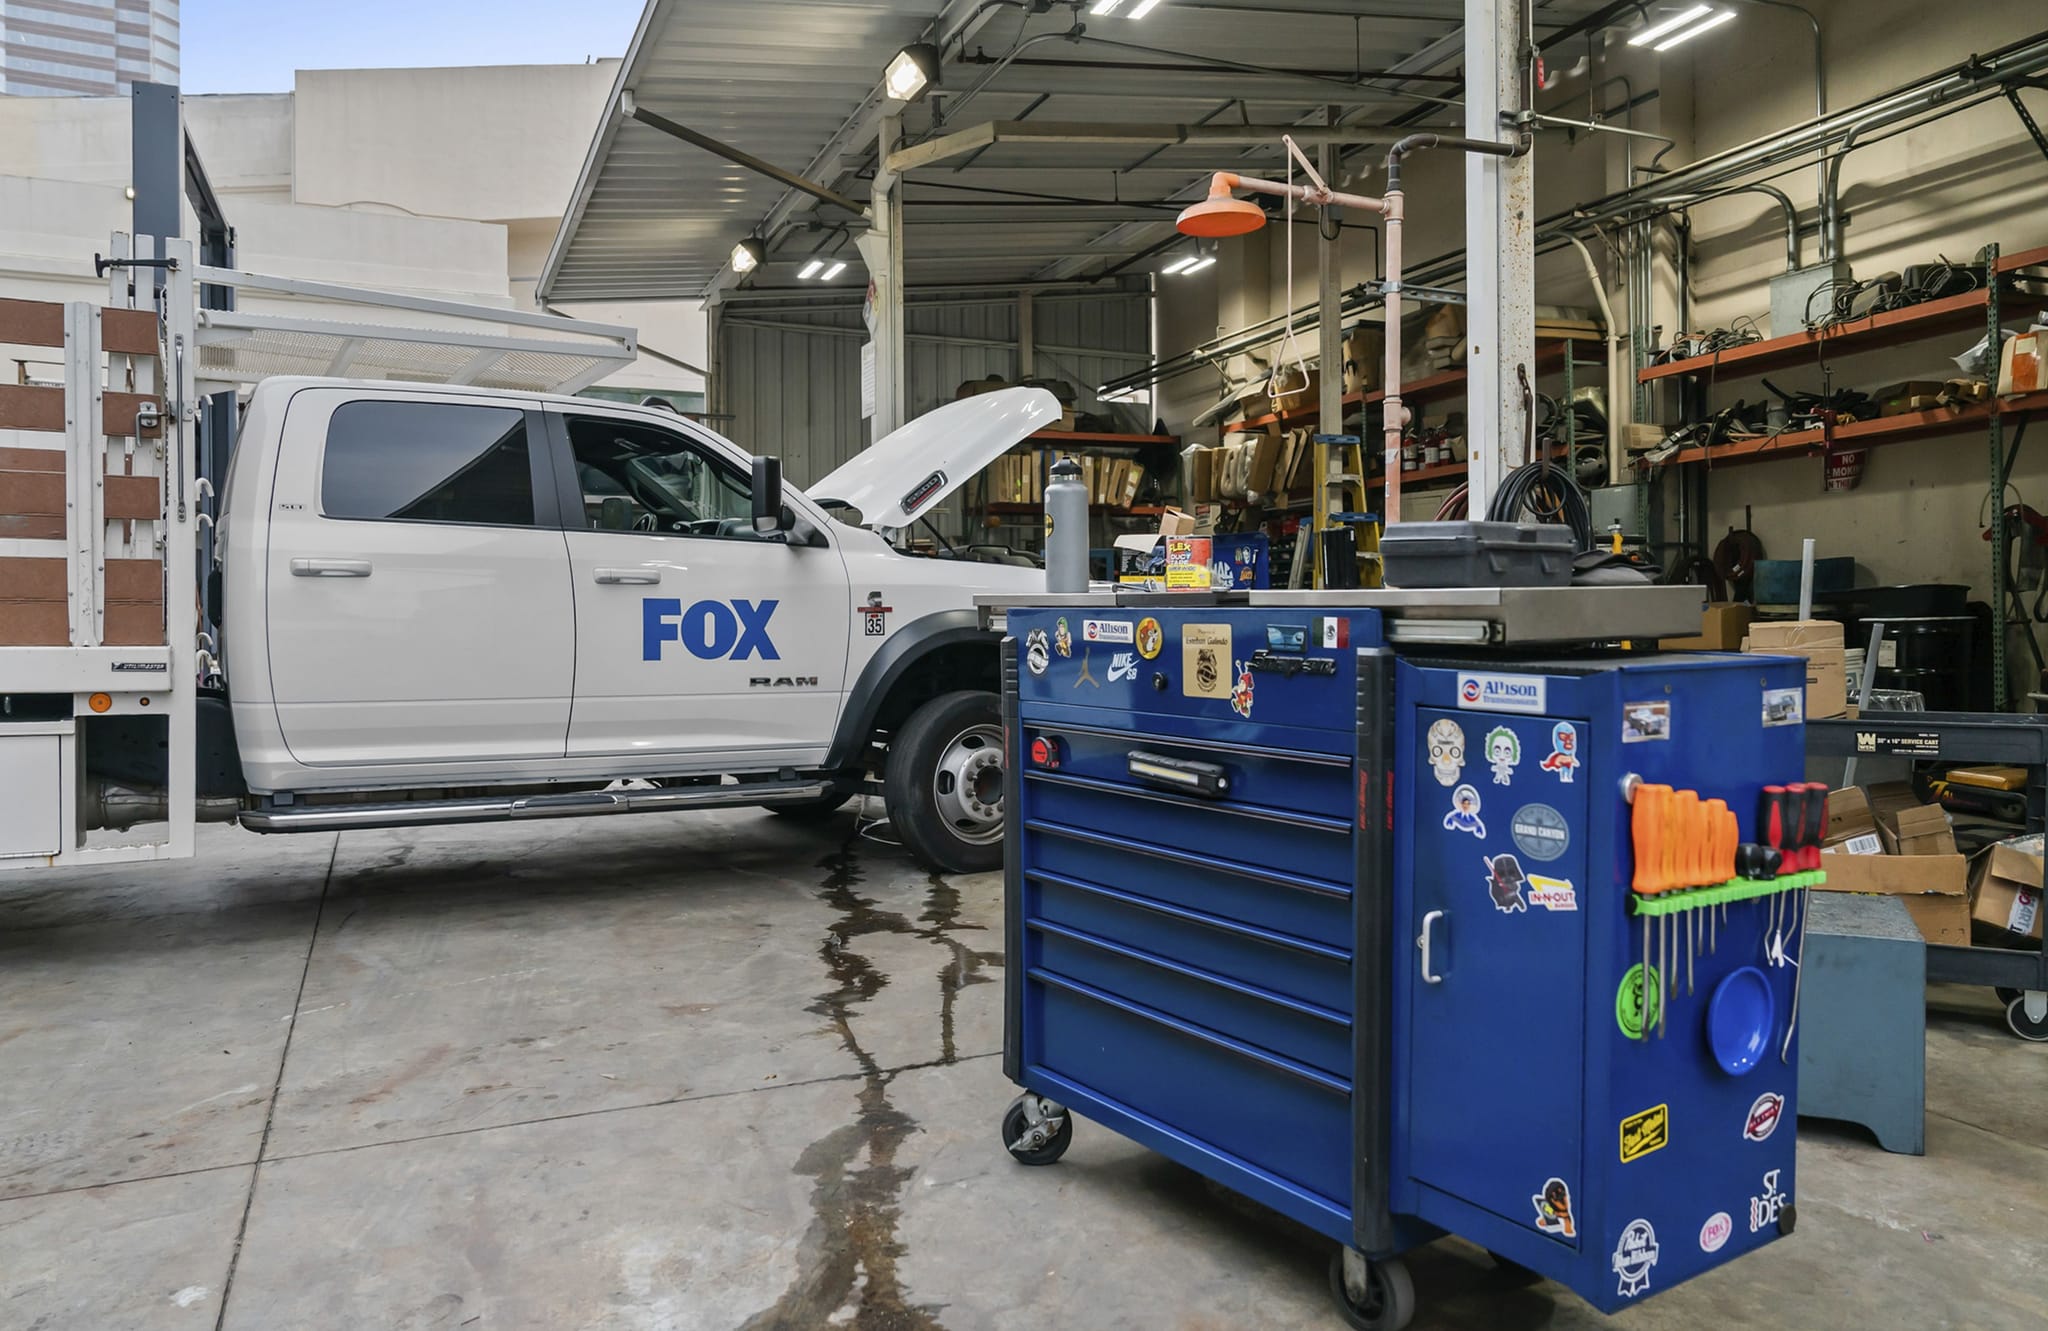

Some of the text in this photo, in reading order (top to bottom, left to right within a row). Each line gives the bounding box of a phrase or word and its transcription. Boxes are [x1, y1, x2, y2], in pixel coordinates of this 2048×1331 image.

[1842, 454, 1855, 465] NO
[1169, 541, 1193, 552] FLEX
[642, 597, 781, 662] FOX
[867, 618, 882, 634] 35
[1100, 623, 1128, 634] Allison
[1112, 652, 1134, 668] NIKE
[1126, 668, 1138, 680] SB
[749, 676, 818, 687] RAM
[1483, 681, 1537, 697] Allison
[1530, 889, 1574, 903] IN-N-OUT
